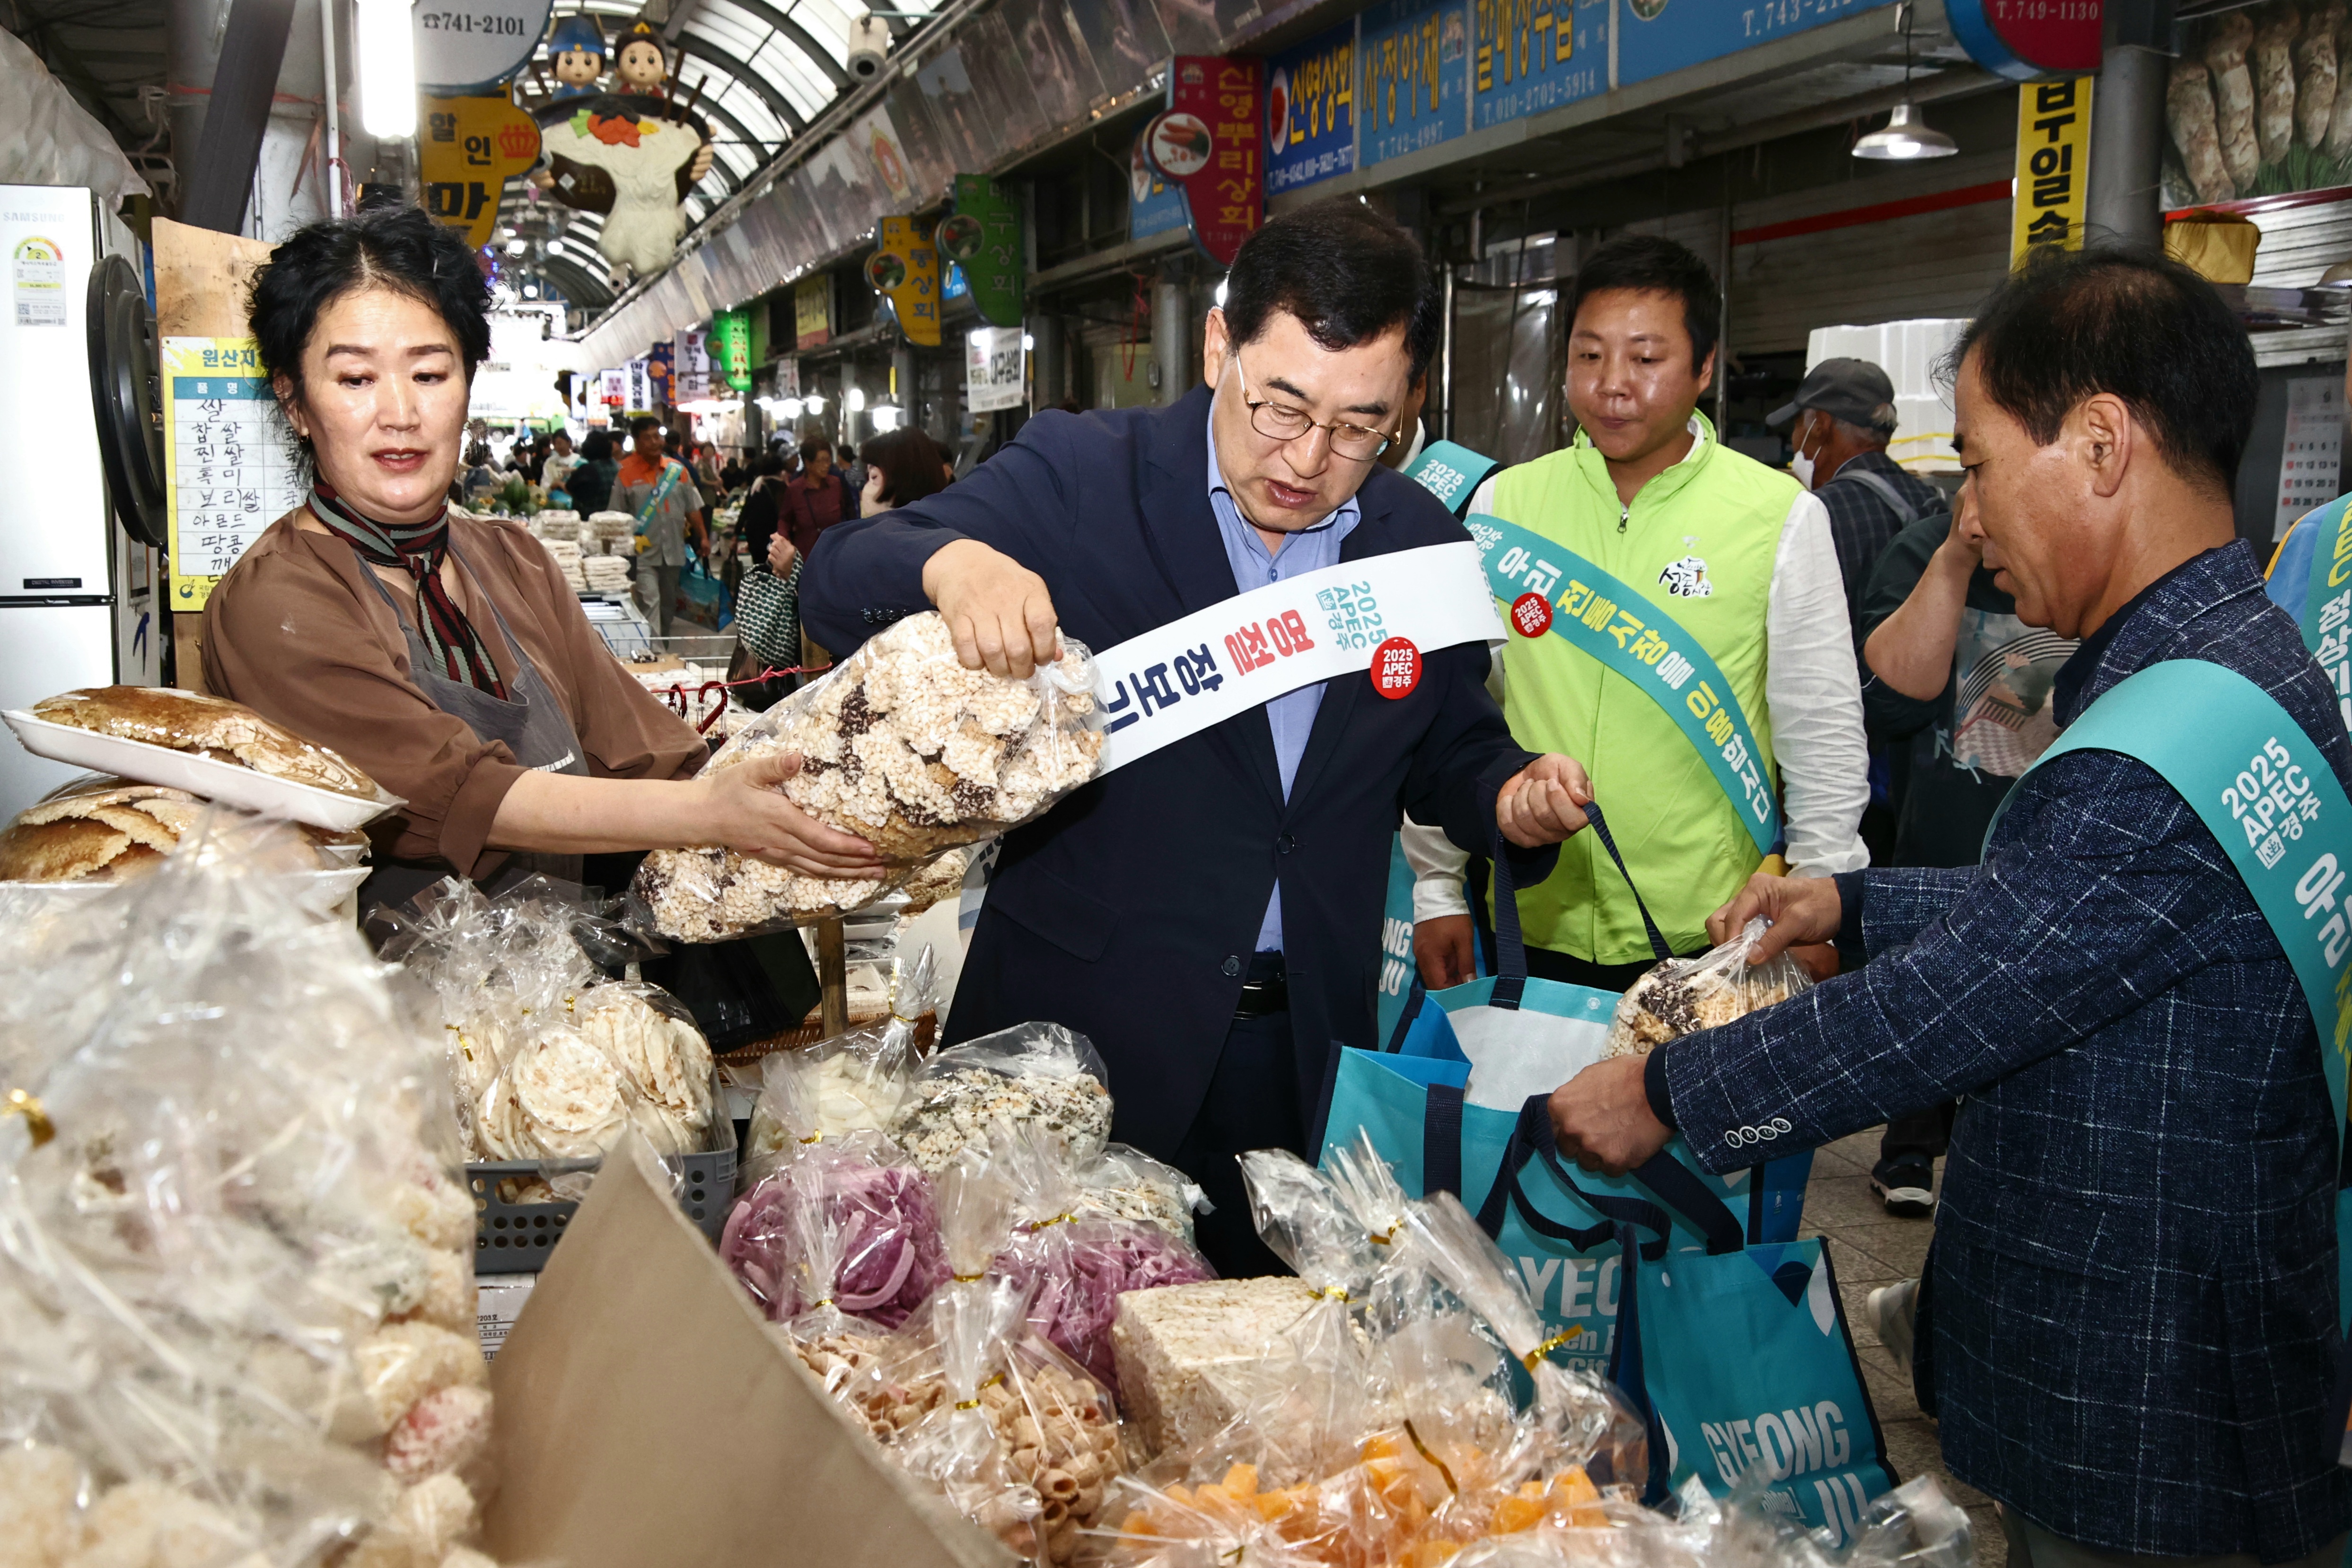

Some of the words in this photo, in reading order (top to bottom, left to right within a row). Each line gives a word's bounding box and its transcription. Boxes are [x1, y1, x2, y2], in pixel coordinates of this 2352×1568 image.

[441, 12, 525, 36] 741-2101
[1996, 1, 2098, 21] T.749-1130
[3, 212, 65, 222] SAMSUNG
[1417, 468, 1457, 497] APEC
[1425, 459, 1466, 487] 2025
[1497, 546, 1562, 598] 우리
[1333, 586, 1367, 649] APEC
[1351, 581, 1388, 645] 2025
[1514, 596, 1538, 618] 2025
[1519, 605, 1543, 626] APEC
[1532, 613, 1547, 628] 경주
[1224, 609, 1315, 676] 명절
[1328, 612, 1352, 651] 경주
[1382, 662, 1413, 675] APEC
[1383, 648, 1413, 662] 2025
[1105, 643, 1223, 735] 장보기
[1393, 676, 1412, 688] 경주
[1555, 579, 1696, 690] 전통시장을
[1686, 680, 1771, 824] 이용합시다
[2221, 736, 2290, 820] 2025
[2241, 764, 2310, 849] APEC
[2278, 791, 2321, 840] 경주
[1382, 918, 1413, 958] NG
[1378, 958, 1406, 996] JU
[1701, 1400, 1850, 1489] GYEONG
[1814, 1472, 1869, 1549] JU
